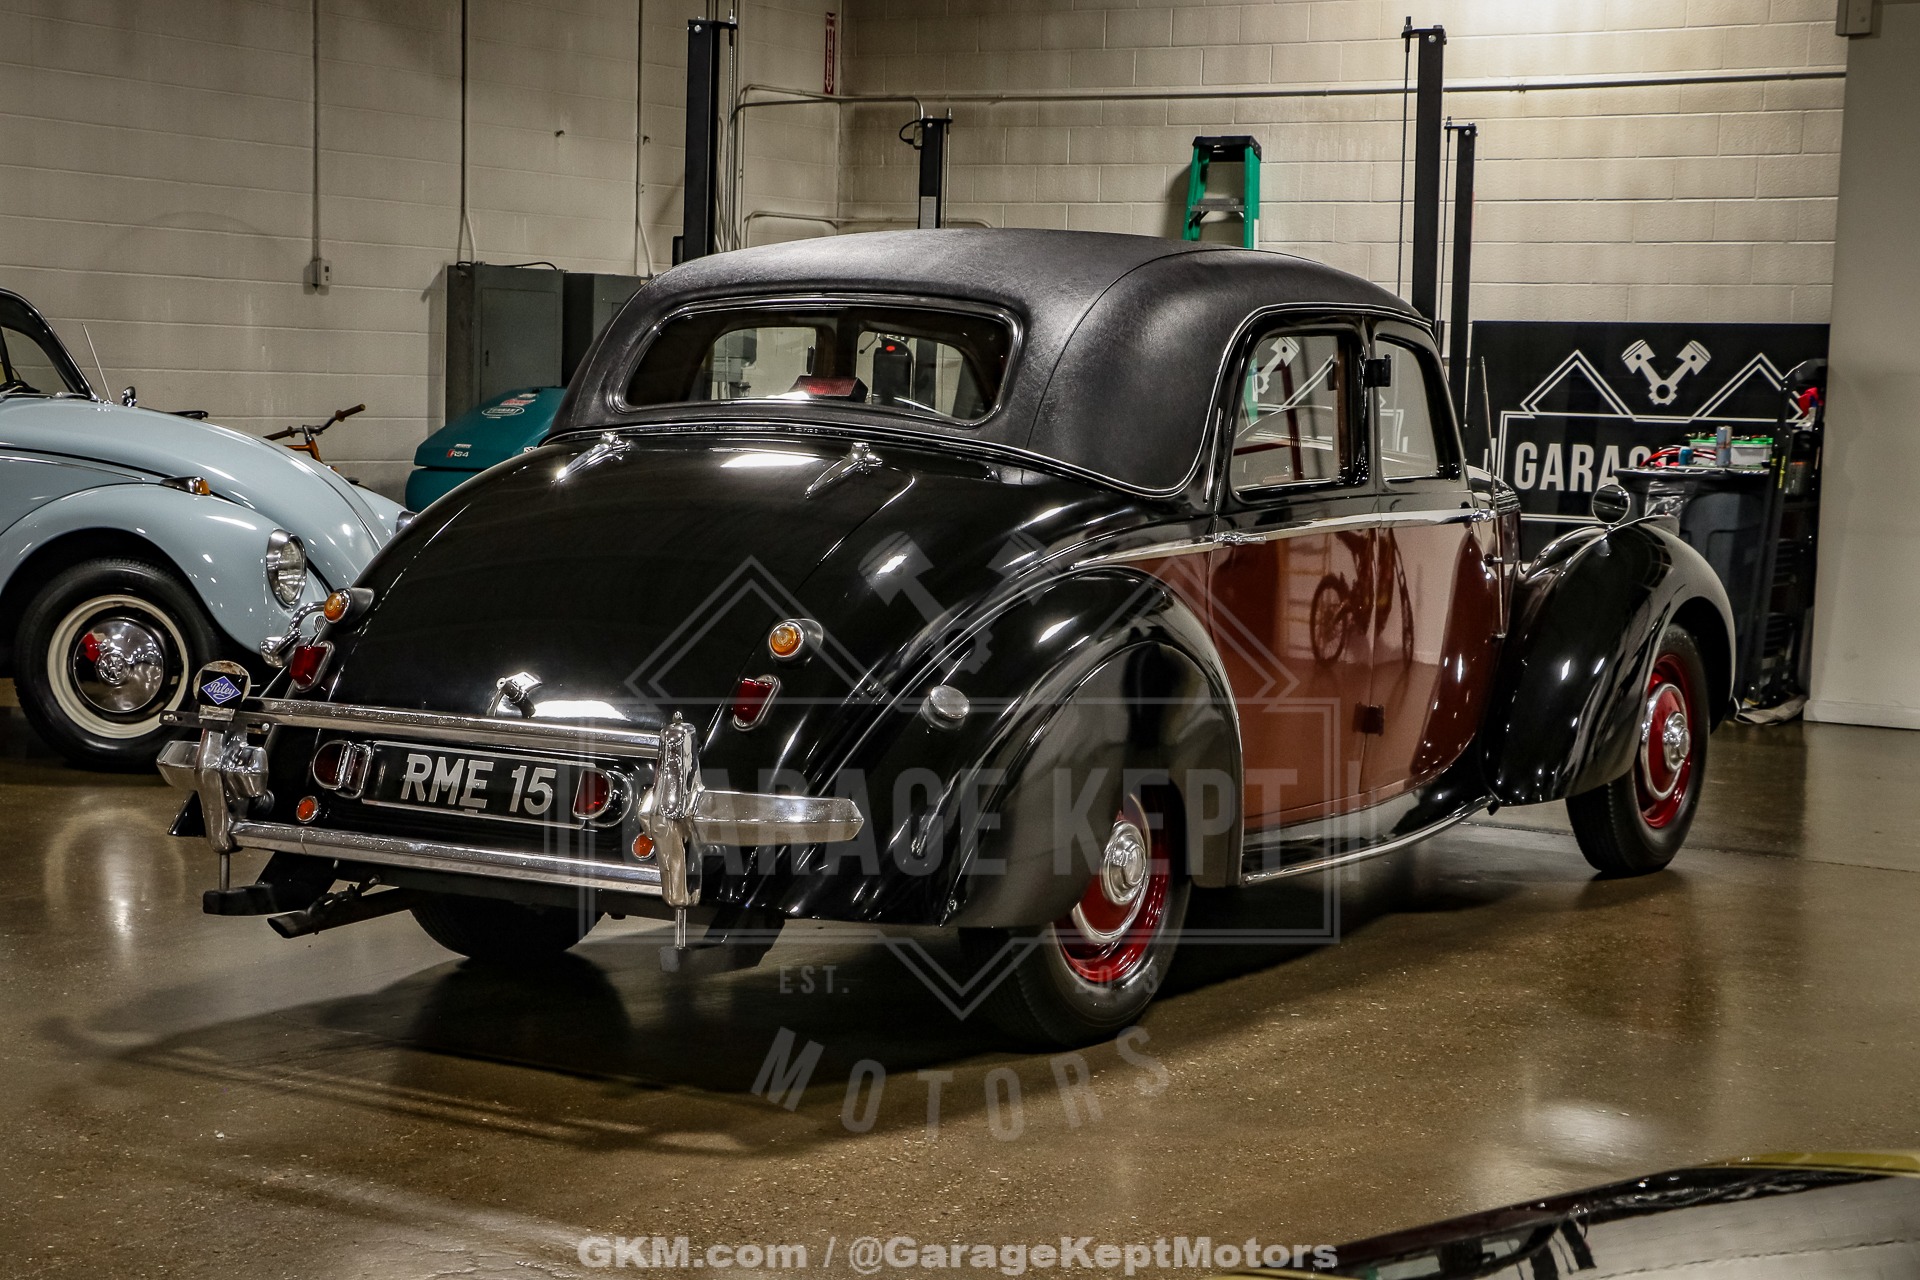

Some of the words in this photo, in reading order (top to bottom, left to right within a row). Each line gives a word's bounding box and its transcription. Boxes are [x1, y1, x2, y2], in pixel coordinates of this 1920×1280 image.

[1514, 442, 1667, 492] GARA
[207, 681, 236, 700] Riley
[400, 753, 494, 809] RME
[509, 765, 557, 816] 15
